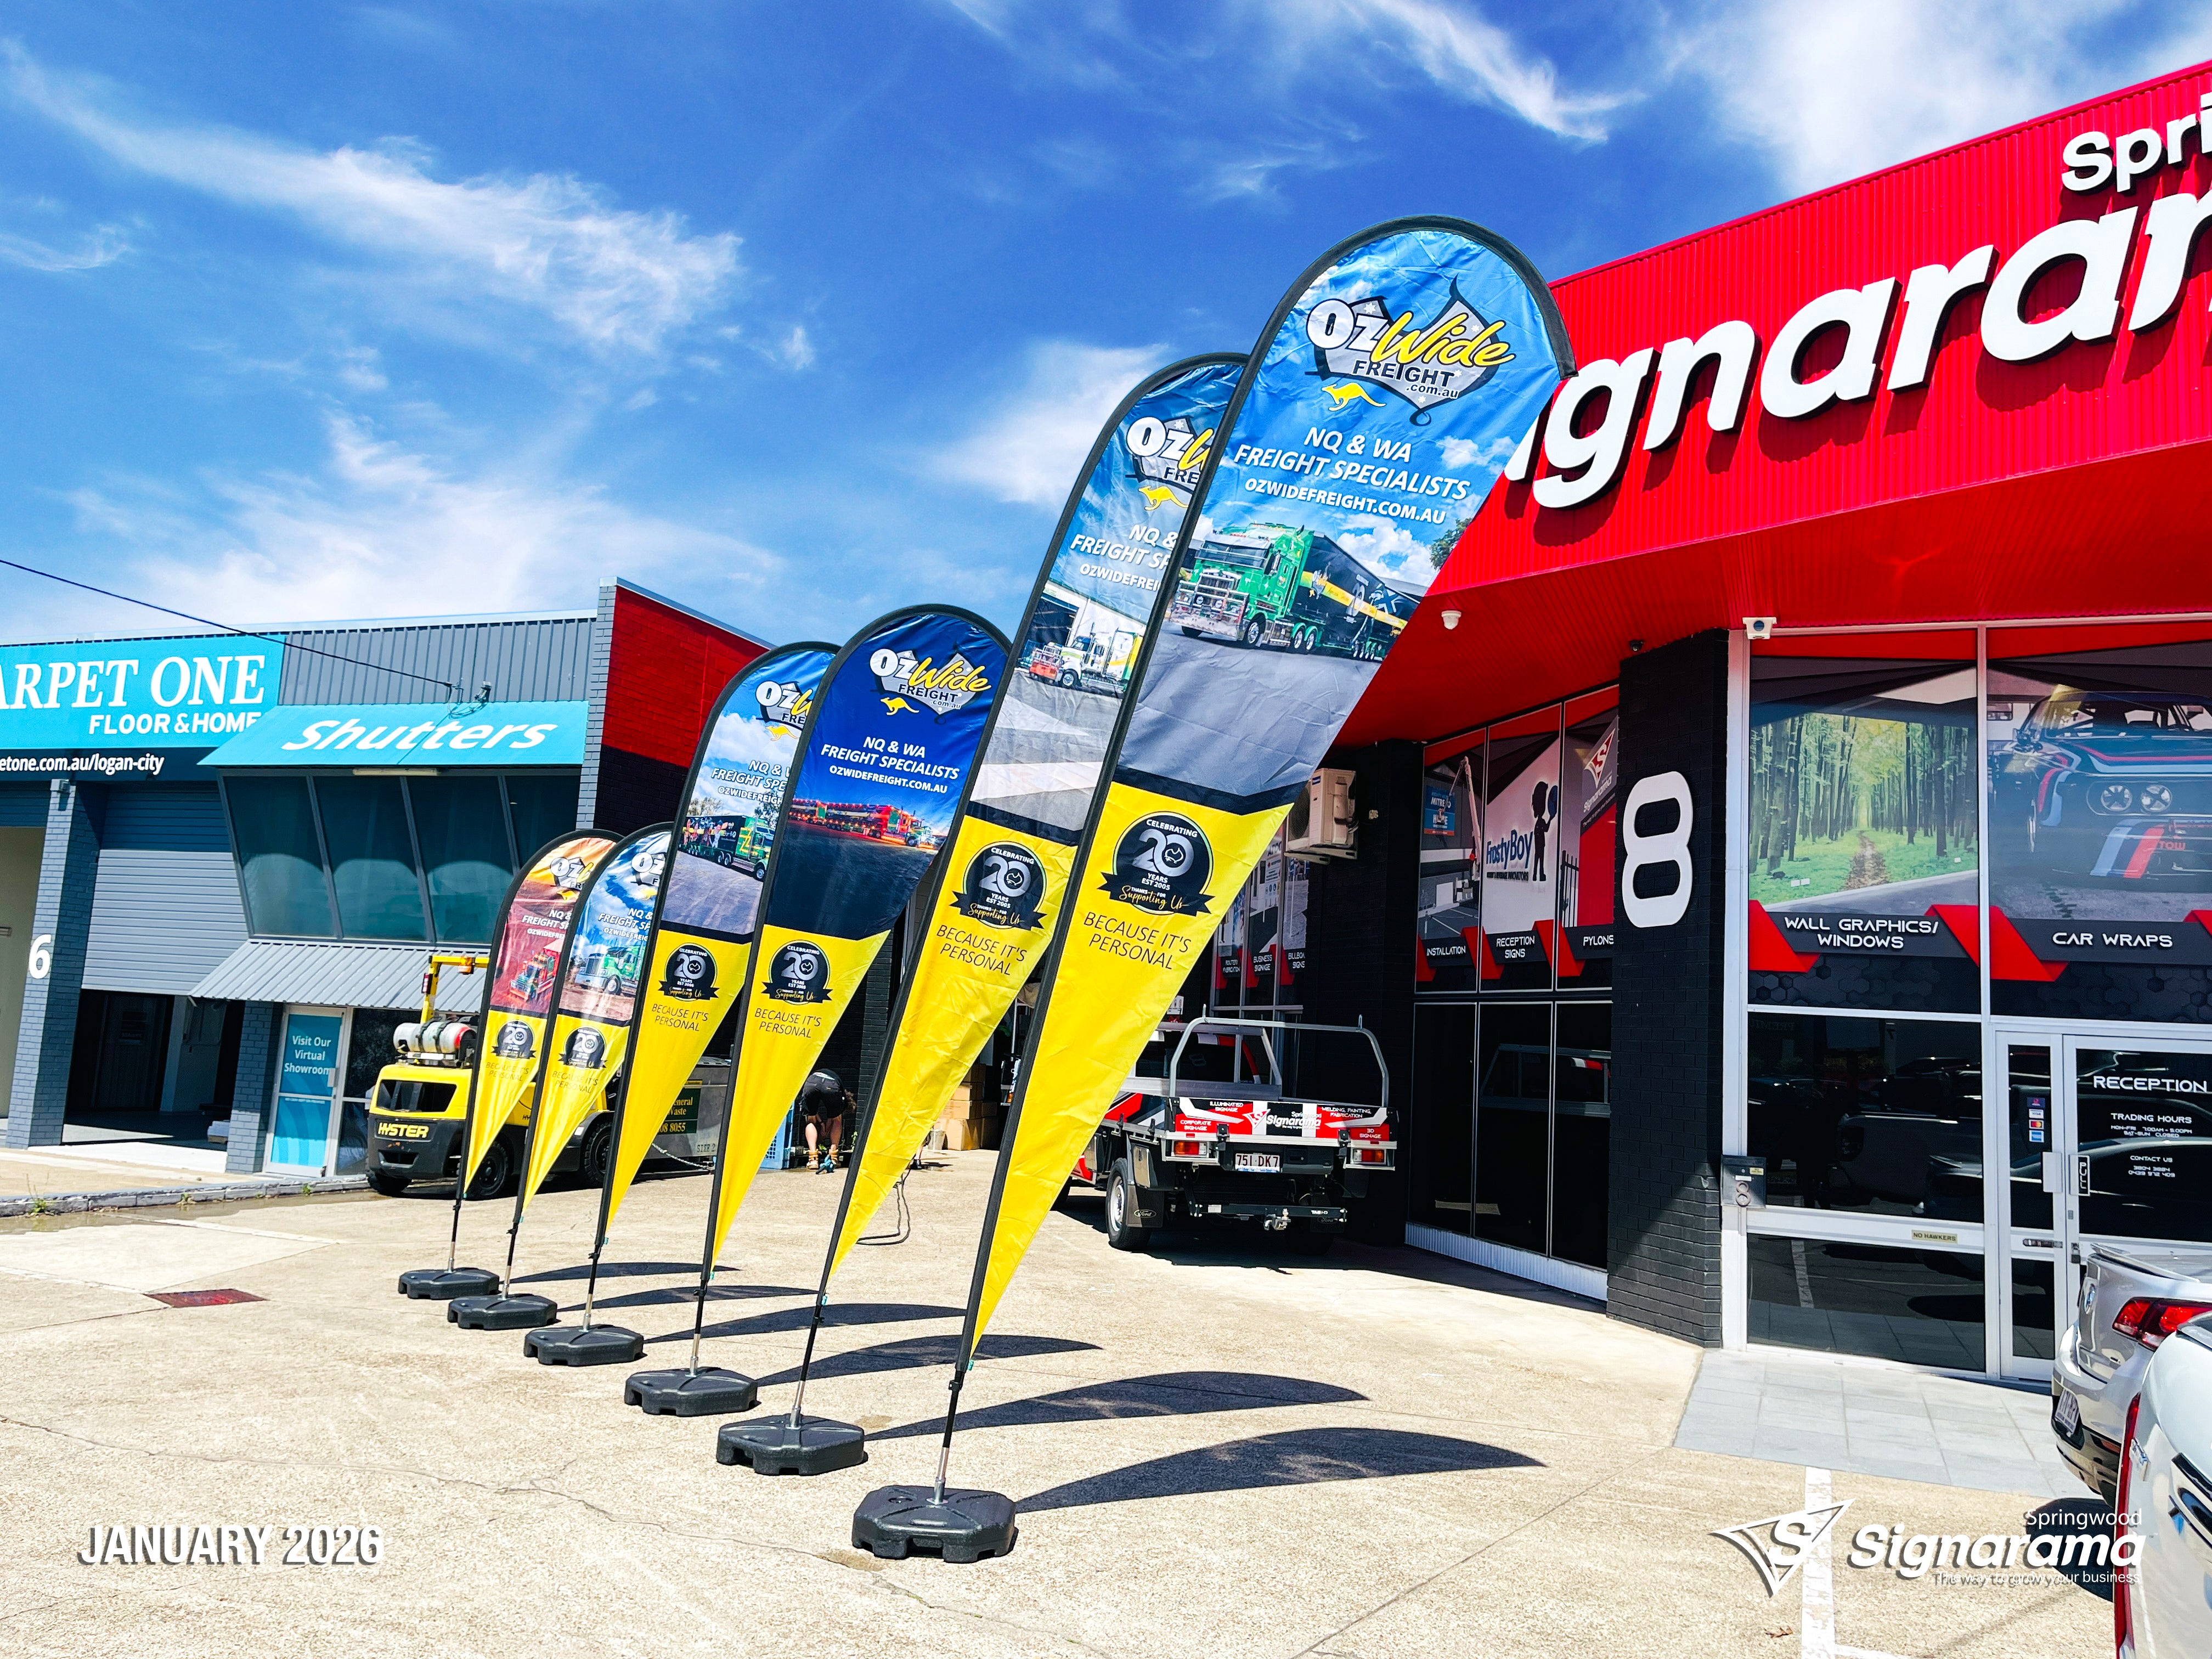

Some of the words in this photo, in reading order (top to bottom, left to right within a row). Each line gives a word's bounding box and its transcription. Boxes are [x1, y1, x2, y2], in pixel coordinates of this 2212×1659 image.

[1504, 190, 2212, 508] gnara
[1352, 359, 1455, 388] FREIGHT
[1406, 382, 1459, 399] .com.au
[1304, 426, 1343, 455] NQ
[1346, 434, 1365, 455] &
[1373, 437, 1412, 464] WA
[1234, 444, 1330, 477] FREIGHT
[1330, 460, 1471, 501] SPECIALISTS
[1245, 478, 1447, 525] OZWIDEFREIGHT.COM.AU
[1129, 524, 1161, 547] NQ
[1162, 531, 1178, 550] &
[1070, 533, 1150, 565] FREIGHT
[0, 659, 139, 709] RPET
[150, 655, 265, 707] ONE
[898, 684, 958, 703] FREIGHT
[89, 713, 171, 735] FLOOR
[174, 712, 189, 733] &
[281, 718, 558, 751] Shutters
[863, 736, 885, 753] NQ
[888, 741, 899, 754] &
[904, 743, 926, 758] WA
[748, 760, 769, 775] NQ
[771, 764, 782, 776] &
[821, 744, 879, 768] FREIGHT
[879, 756, 960, 780] SPECIALISTS
[711, 768, 764, 787] FREIGHT
[829, 765, 948, 794] OZWIDEFREIGHT.COM.AU
[1146, 819, 1198, 838] CELEBRATING
[991, 847, 1035, 865] CELEBRATING
[1132, 828, 1194, 877] 20
[1622, 771, 1693, 928] 8
[979, 855, 1031, 897] 20
[1141, 878, 1154, 888] EST
[1153, 881, 1170, 890] 2005
[1148, 872, 1168, 883] YEARS
[991, 893, 1009, 902] YEARS
[1119, 885, 1167, 910] Supporting
[1171, 895, 1189, 910] Us
[1131, 887, 1148, 895] THANKS
[986, 898, 997, 906] EST
[522, 915, 560, 928] FREIGHT
[549, 909, 564, 919] NQ
[598, 913, 638, 929] FREIGHT
[628, 908, 645, 918] NQ
[645, 911, 653, 919] &
[967, 902, 1007, 924] Supporting
[1084, 912, 1159, 945] BECAUSE
[1161, 933, 1192, 953] IT'S
[1784, 917, 1830, 930] WALL
[1838, 918, 1938, 934] GRAPHICS/
[936, 924, 1000, 953] BECAUSE
[1000, 944, 1027, 962] IT'S
[1496, 935, 1535, 947] RECEPTION
[1583, 935, 1614, 946] PYLONS
[1818, 934, 1904, 949] WINDOWS
[2052, 932, 2094, 946] CAR
[2102, 933, 2174, 949] WRAPS
[29, 934, 52, 979] 6
[679, 947, 708, 957] CELEBRATING
[787, 945, 820, 955] CELEBRATING
[1088, 933, 1173, 969] PERSONAL
[1426, 946, 1466, 956] INSTALLATION
[1504, 949, 1525, 959] SIGNS
[674, 953, 706, 979] 20
[781, 951, 819, 980] 20
[940, 943, 1011, 975] PERSONAL
[1253, 955, 1272, 963] BUSINESS
[652, 1003, 689, 1019] BECAUSE
[691, 1011, 709, 1022] IT'S
[755, 1008, 801, 1024] BECAUSE
[802, 1015, 822, 1027] IT'S
[655, 1015, 699, 1031] PERSONAL
[759, 1021, 811, 1038] PERSONAL
[292, 1035, 311, 1045] Visit
[314, 1037, 331, 1047] Our
[295, 1049, 325, 1060] Virtual
[486, 1062, 516, 1073] BECAUSE
[489, 1070, 523, 1081] PERSONAL
[552, 1071, 584, 1082] BECAUSE
[2093, 1075, 2207, 1093] RECEPTION
[555, 1081, 592, 1093] PERSONAL
[674, 1097, 693, 1105] eneral
[669, 1122, 686, 1132] 8055
[1266, 1114, 1322, 1128] Signarama
[2111, 1113, 2154, 1122] TRADING
[2158, 1115, 2192, 1124] HOURS
[377, 1122, 429, 1138] HYSTER
[1924, 1233, 1956, 1242] HAWKERS
